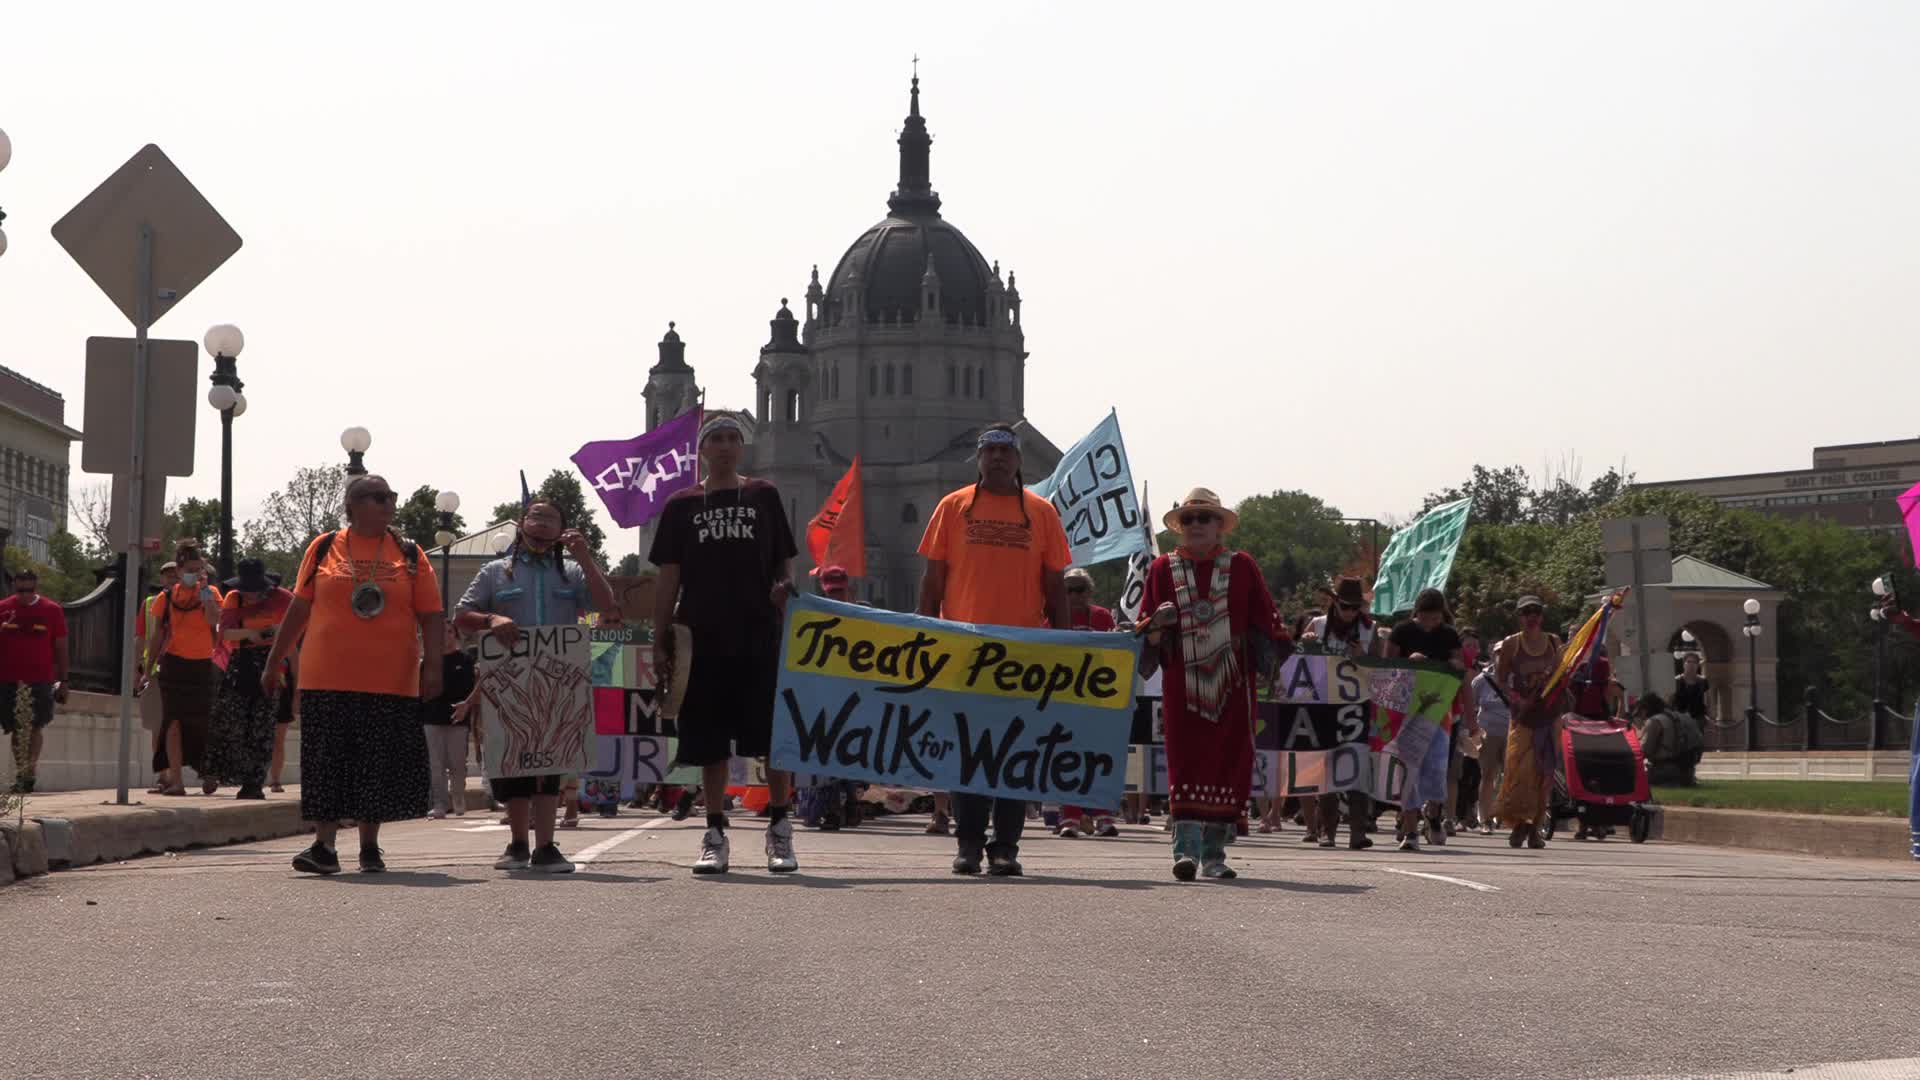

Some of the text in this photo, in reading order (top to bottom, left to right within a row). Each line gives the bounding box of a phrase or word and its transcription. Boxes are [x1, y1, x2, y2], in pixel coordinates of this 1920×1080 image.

[693, 506, 757, 525] CUSTER
[699, 524, 754, 543] PUNK
[796, 617, 1118, 712] Treaty People
[782, 687, 934, 781] Walk
[917, 731, 954, 761] for
[954, 711, 1113, 795] Water
[519, 751, 554, 770] 1855
